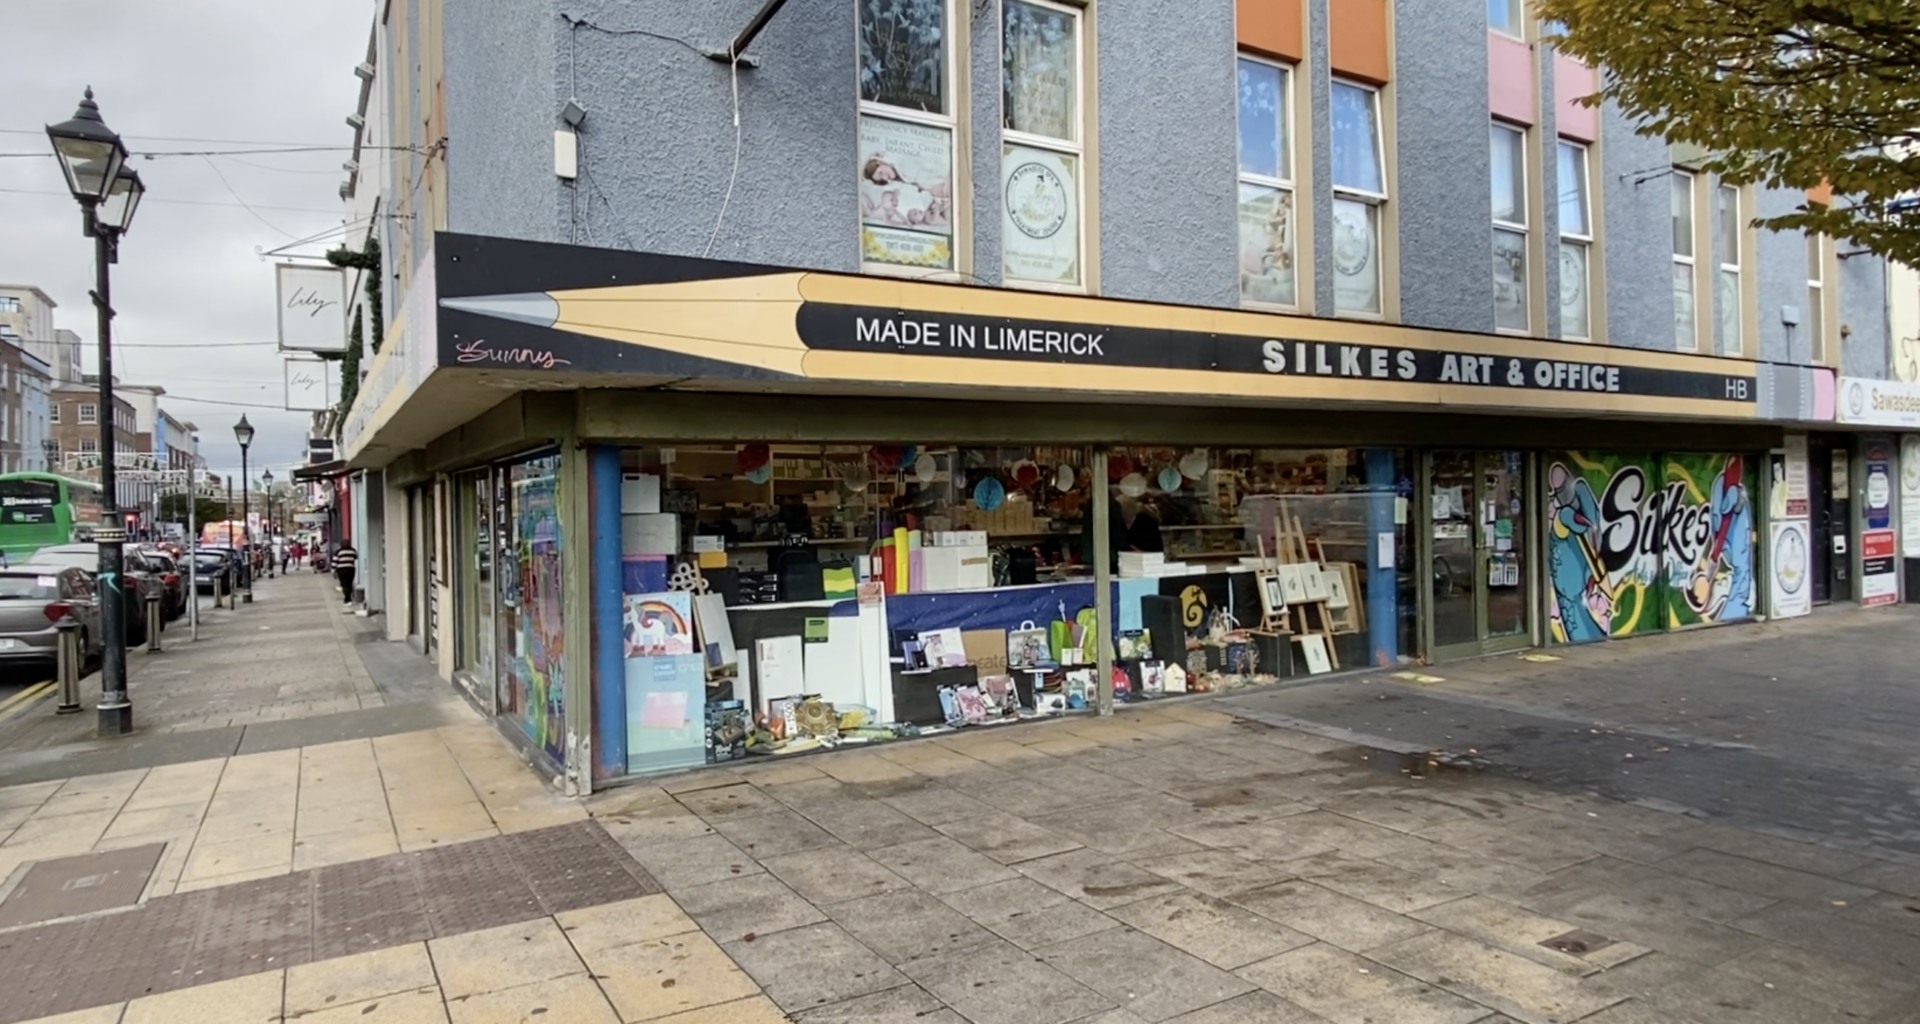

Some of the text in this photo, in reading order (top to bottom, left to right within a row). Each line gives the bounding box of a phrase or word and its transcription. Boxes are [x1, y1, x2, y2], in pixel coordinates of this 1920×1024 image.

[856, 317, 1104, 356] MADE IN LIMERICK
[1262, 339, 1620, 392] SILKES ART & OFFICE
[1724, 377, 1748, 400] HB
[1601, 467, 1710, 572] Silkes
